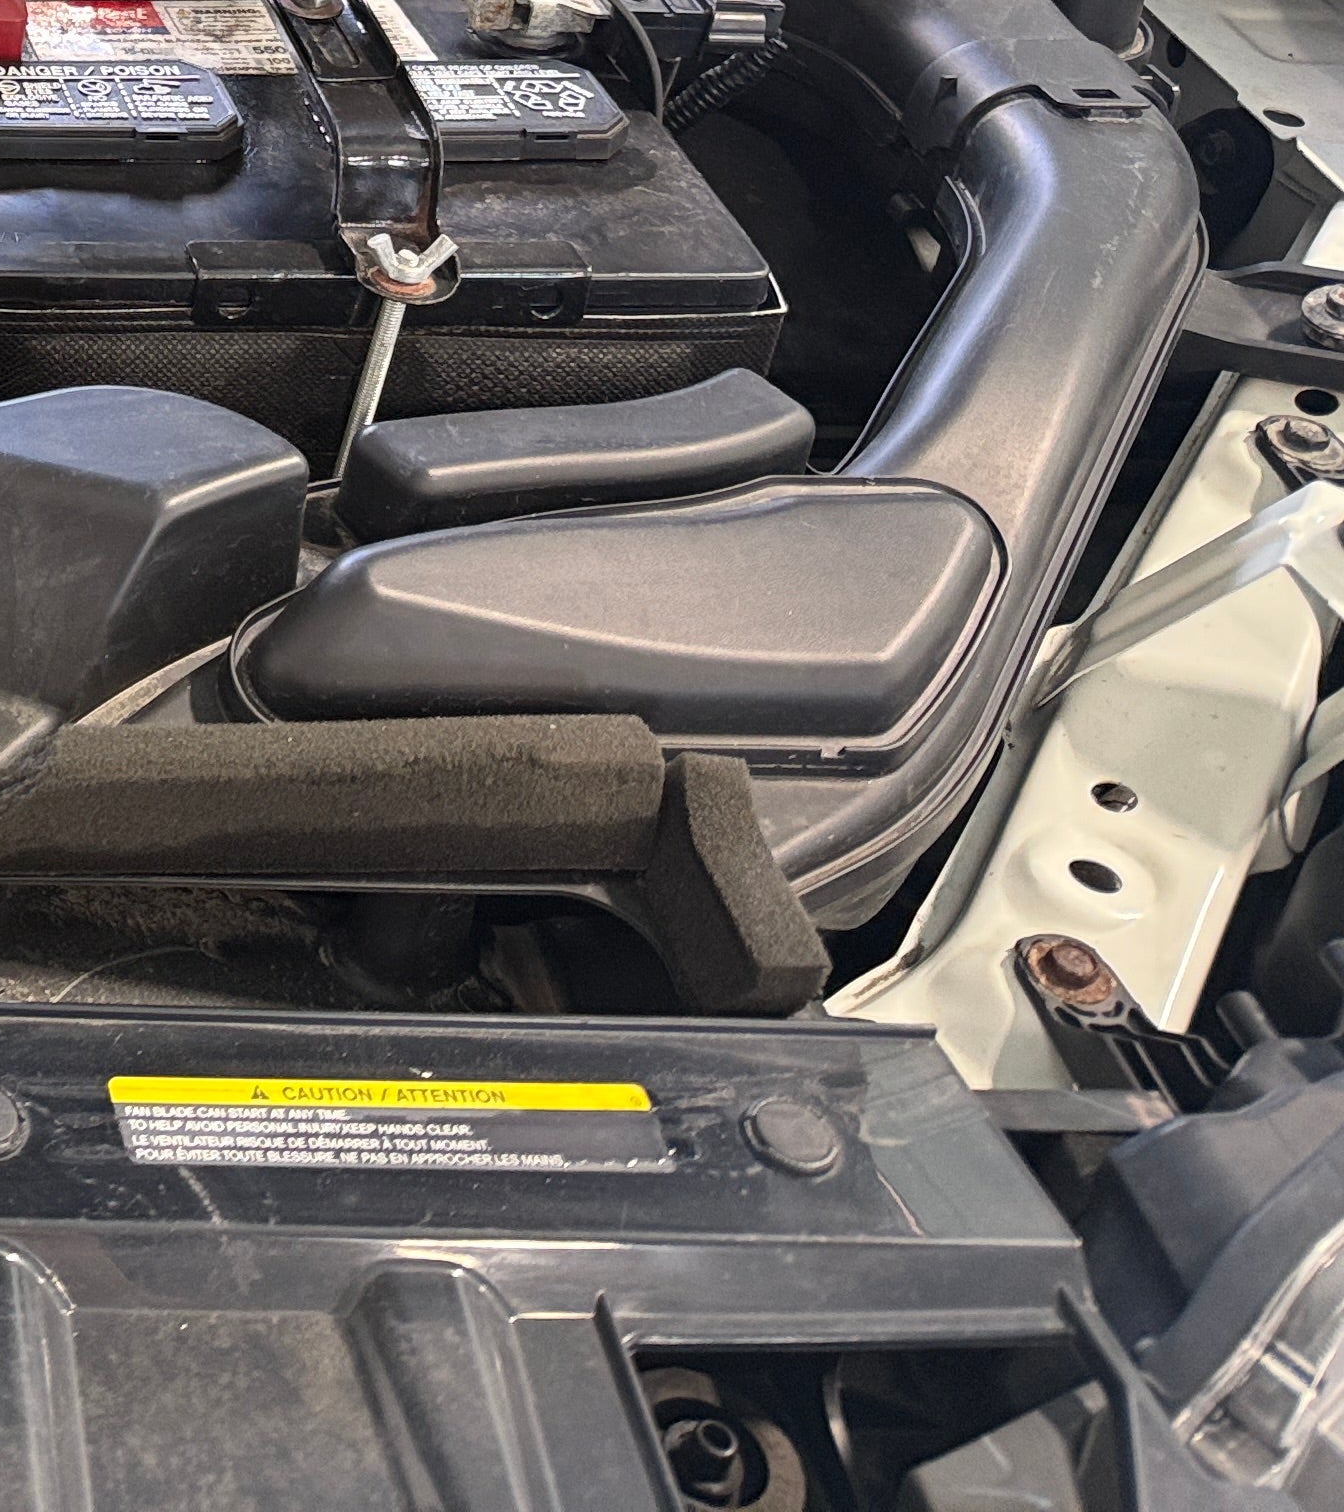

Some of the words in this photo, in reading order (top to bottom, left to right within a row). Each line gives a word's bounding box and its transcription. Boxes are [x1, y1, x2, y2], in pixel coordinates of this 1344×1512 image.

[251, 45, 287, 55] 550
[265, 57, 291, 66] 100
[84, 66, 95, 76] /
[100, 65, 182, 76] POISON
[282, 1087, 372, 1102] CAUTION
[381, 1087, 389, 1101] /
[397, 1089, 506, 1104] ATTENTION
[125, 1106, 151, 1117] FAN
[152, 1106, 195, 1118] BLADE
[197, 1107, 226, 1119] CAN
[228, 1107, 268, 1119] START
[270, 1108, 286, 1119] AT
[288, 1108, 315, 1120] ANY
[127, 1119, 148, 1131] TO
[149, 1119, 184, 1131] HELP
[184, 1120, 226, 1132] AVOID
[226, 1120, 297, 1134] PERSONAL
[378, 1123, 425, 1136] HANDS
[132, 1134, 150, 1146] LE
[150, 1134, 235, 1148] VENTILATEUR
[236, 1136, 286, 1149] RISQUE
[287, 1138, 307, 1149] DE
[307, 1135, 380, 1150] DÉMARRER
[381, 1136, 393, 1150] À
[393, 1138, 427, 1151] TOUT
[135, 1148, 174, 1161] POUR
[175, 1146, 221, 1162] ÉVITER
[221, 1149, 264, 1162] TOUTE
[340, 1151, 359, 1163] NE
[359, 1152, 389, 1165] PAS
[389, 1153, 409, 1165] EN
[410, 1153, 493, 1167] APPROCHER
[493, 1154, 520, 1167] LES
